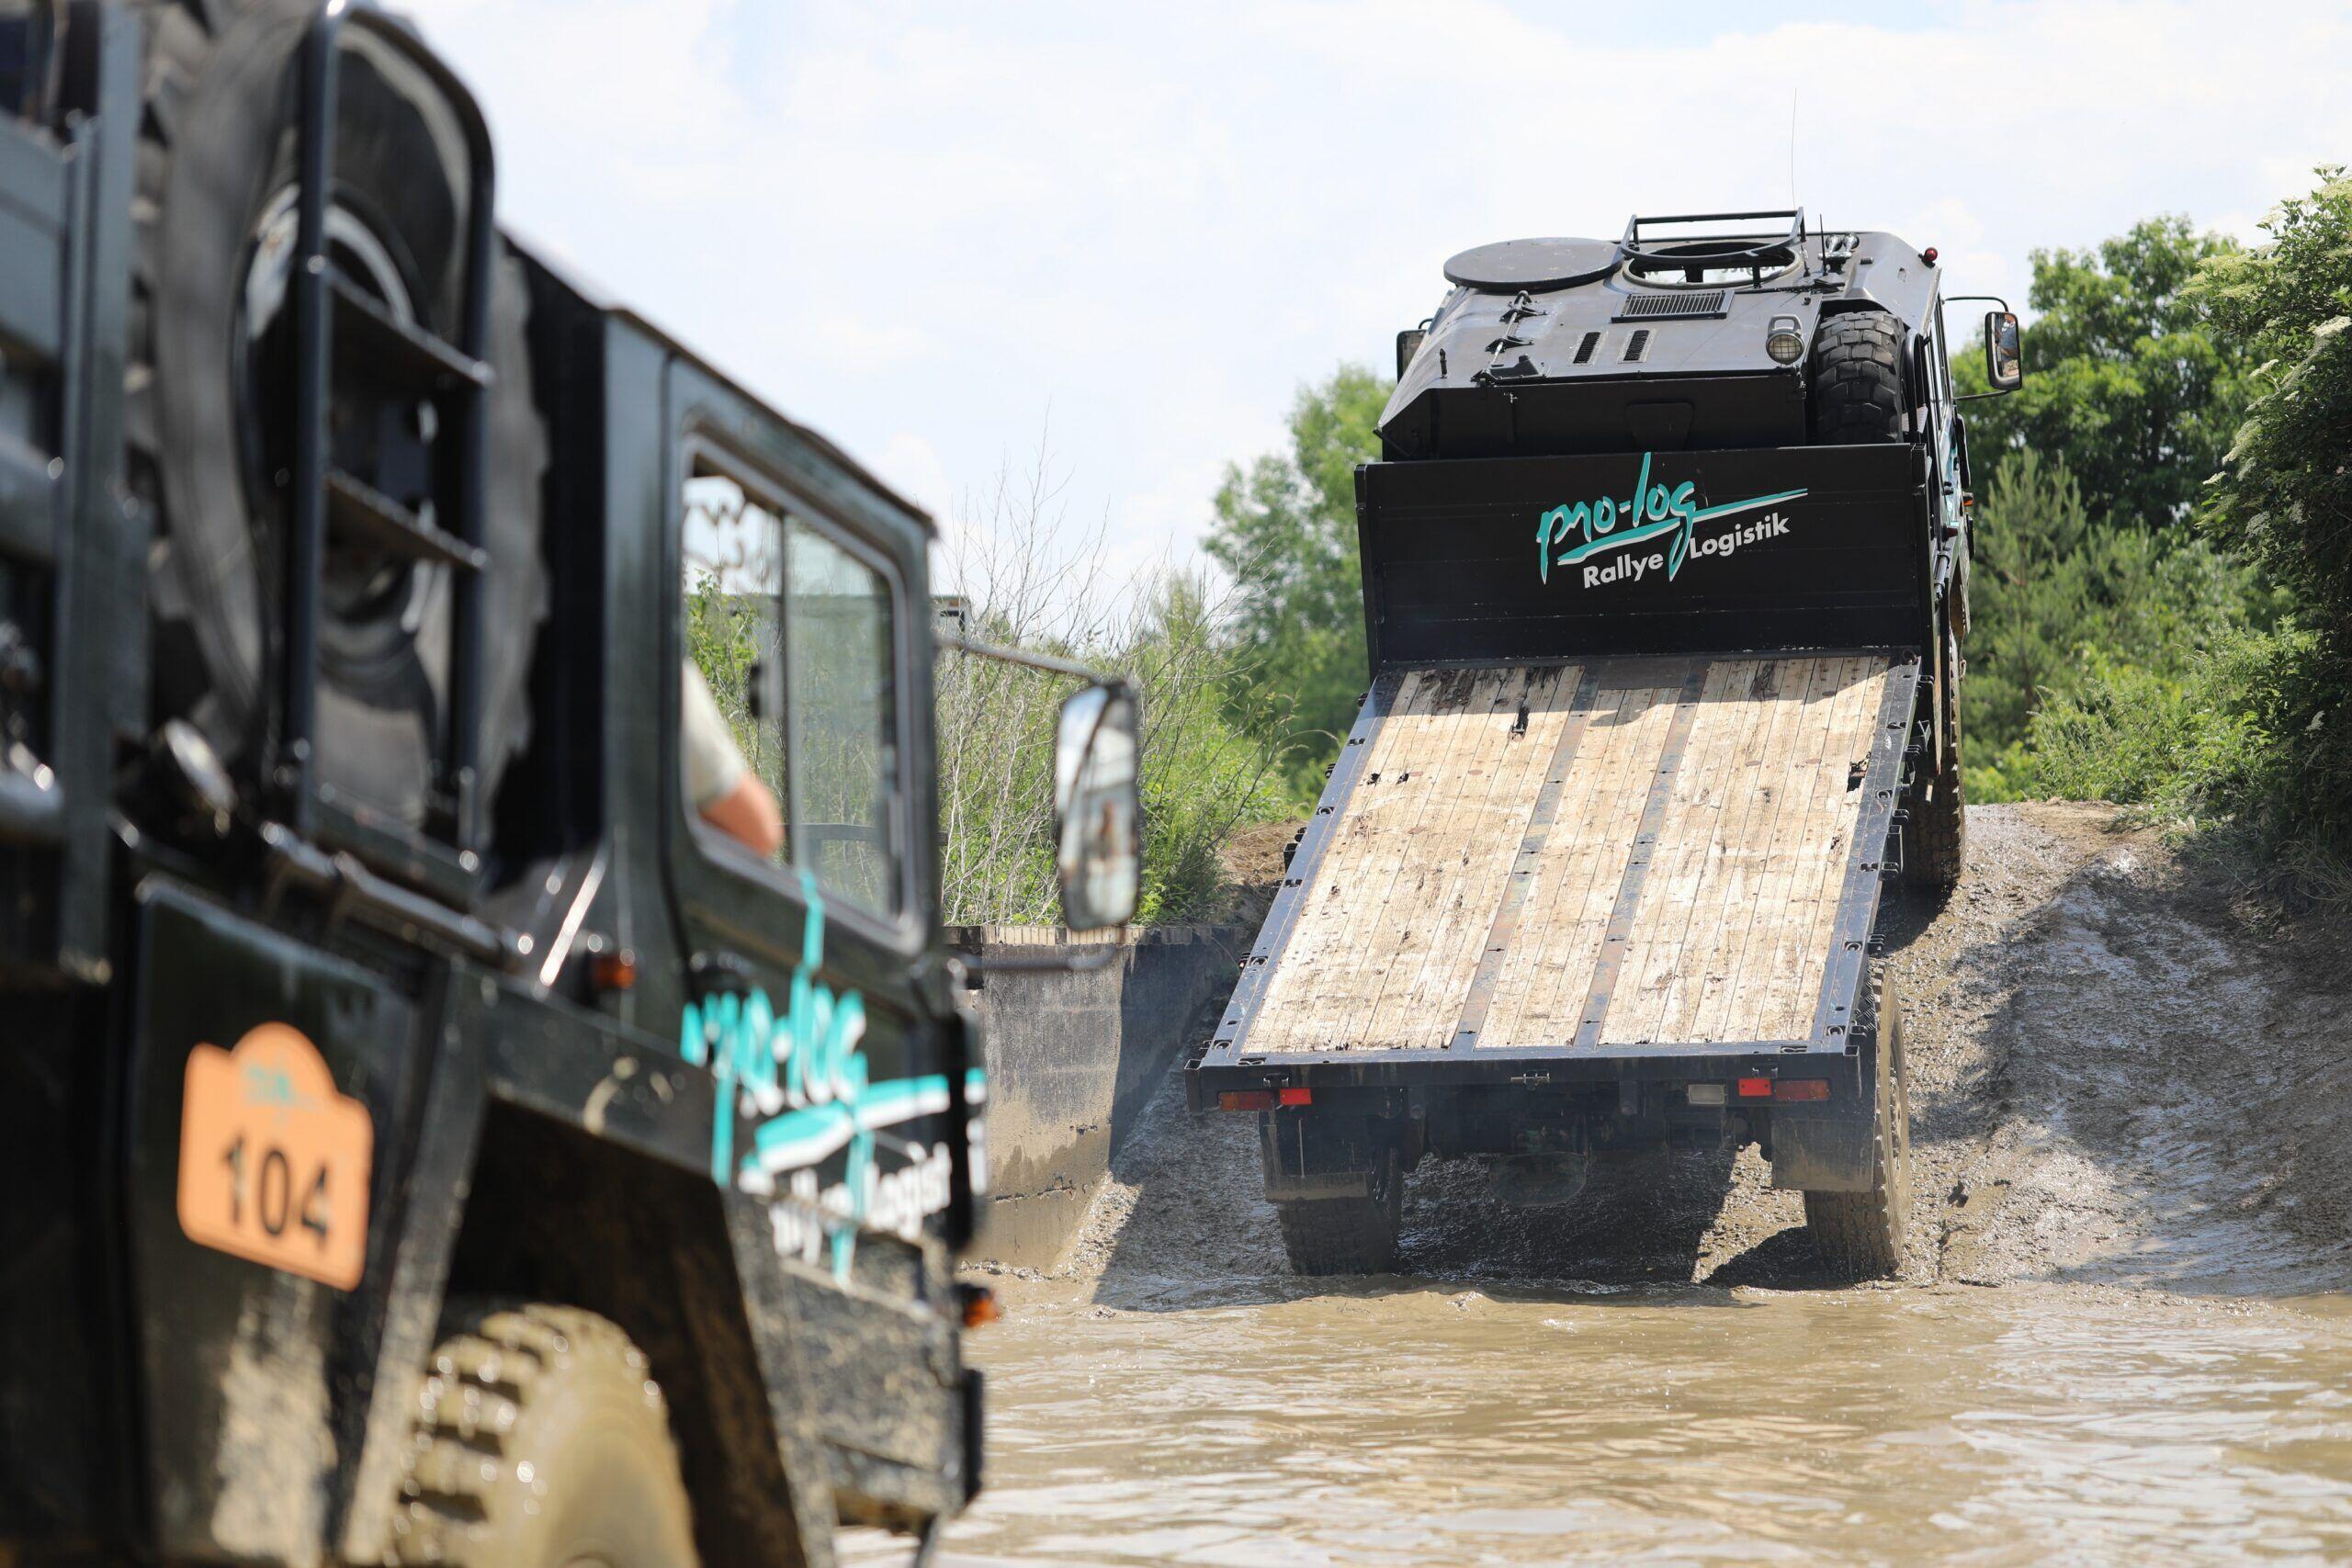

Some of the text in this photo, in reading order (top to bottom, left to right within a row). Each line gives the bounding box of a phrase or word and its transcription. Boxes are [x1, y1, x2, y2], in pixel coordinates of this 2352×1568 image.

[1583, 512, 1791, 589] Rallye Logistik
[221, 1131, 329, 1255] 104
